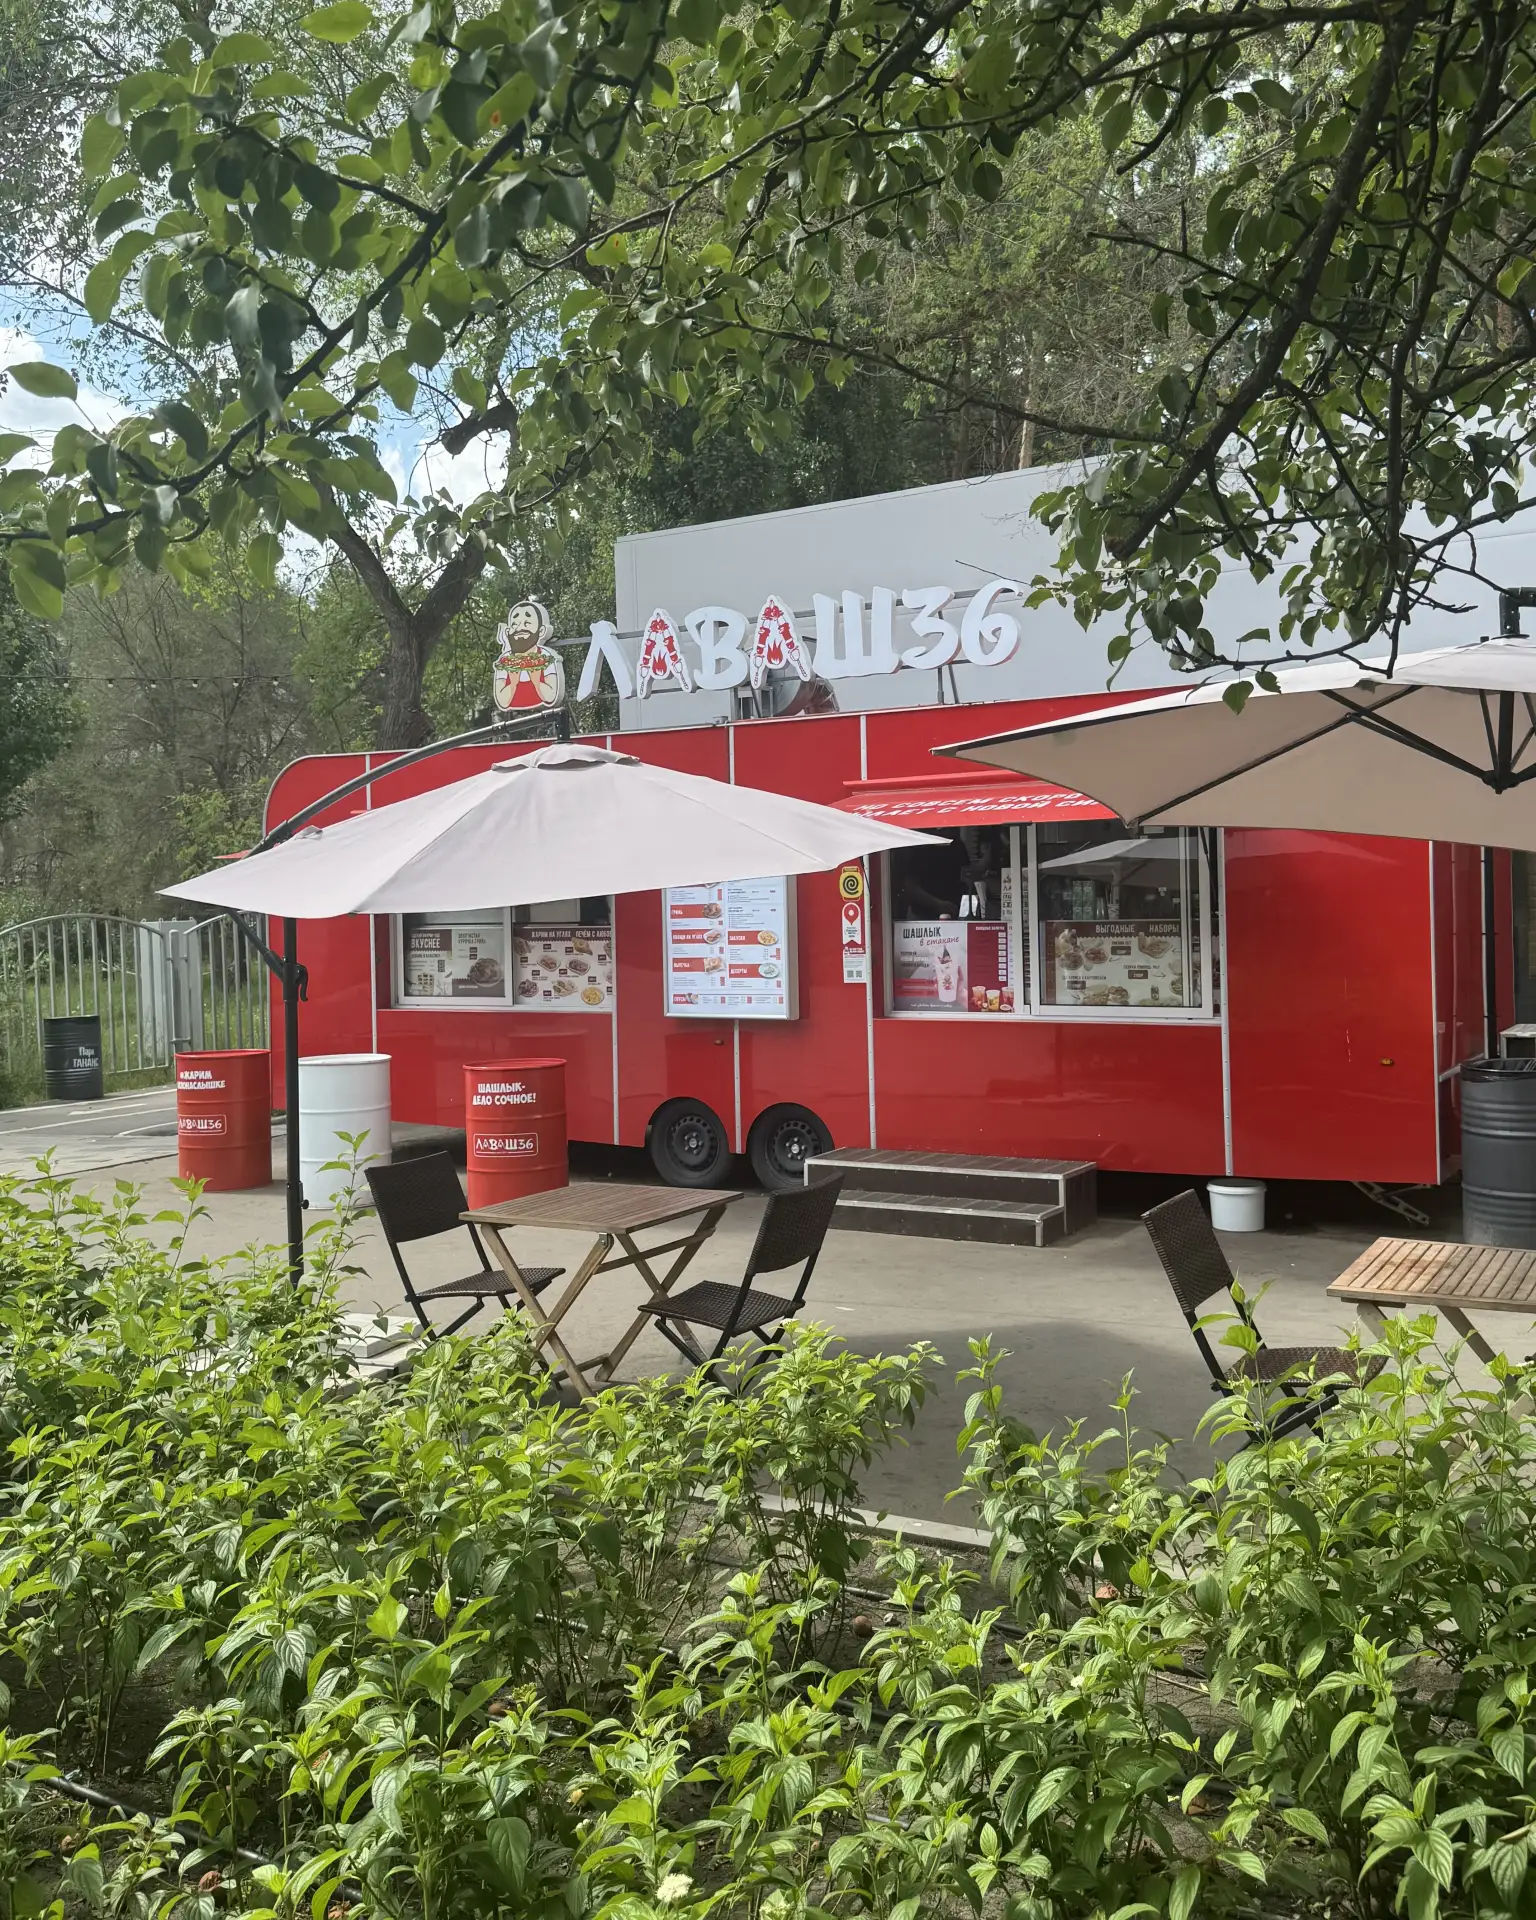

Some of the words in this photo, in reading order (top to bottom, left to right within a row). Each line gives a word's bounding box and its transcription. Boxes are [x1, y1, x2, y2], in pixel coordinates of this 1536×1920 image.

[576, 579, 1022, 703] ЛАВАШ36
[961, 801, 1051, 813] НОВОЙ
[903, 926, 941, 939] ШАШЛЫК
[1095, 924, 1135, 934] ВЫГОДНЫЕ
[1149, 924, 1179, 933] НАБОРЫ
[411, 938, 441, 949] ВКУСНЕЕ
[926, 937, 960, 946] стакане
[472, 1094, 492, 1106] ДЕЛО
[494, 1093, 536, 1105] СОЧНОЕ!
[476, 1138, 534, 1150] ЛАВАШ36
